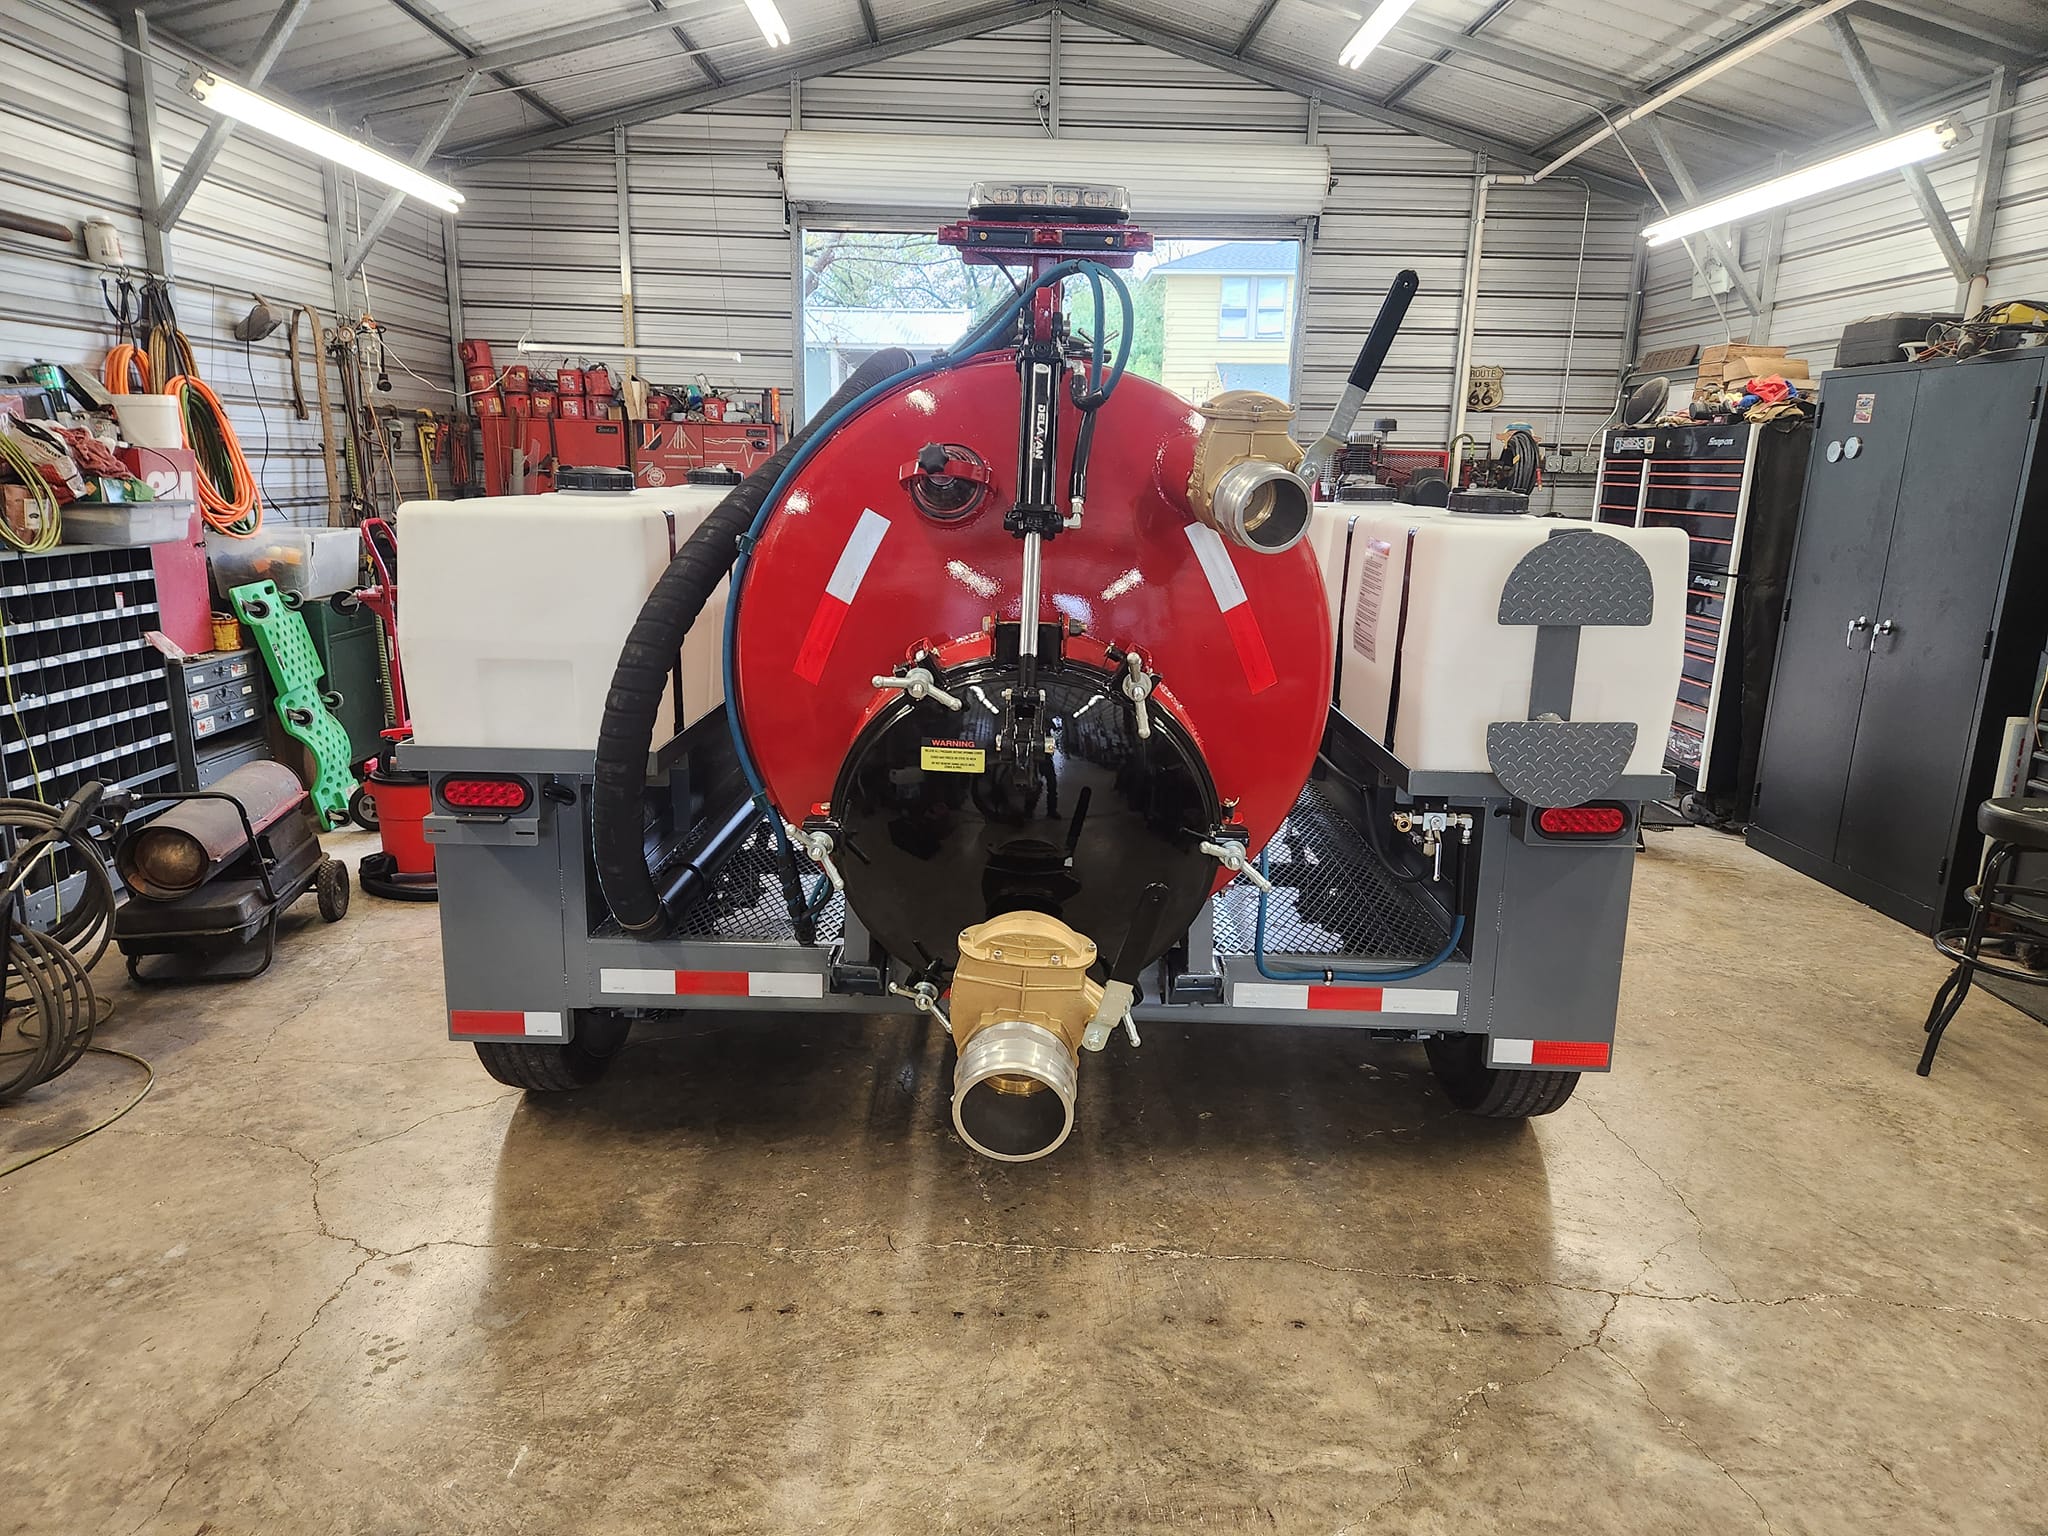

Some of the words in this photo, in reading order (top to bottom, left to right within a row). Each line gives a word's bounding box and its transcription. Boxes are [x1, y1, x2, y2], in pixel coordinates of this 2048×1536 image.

[1470, 369, 1497, 378] ROUTE
[1469, 389, 1493, 406] 66
[1034, 404, 1046, 460] DELAVAN
[931, 739, 975, 748] WARNING
